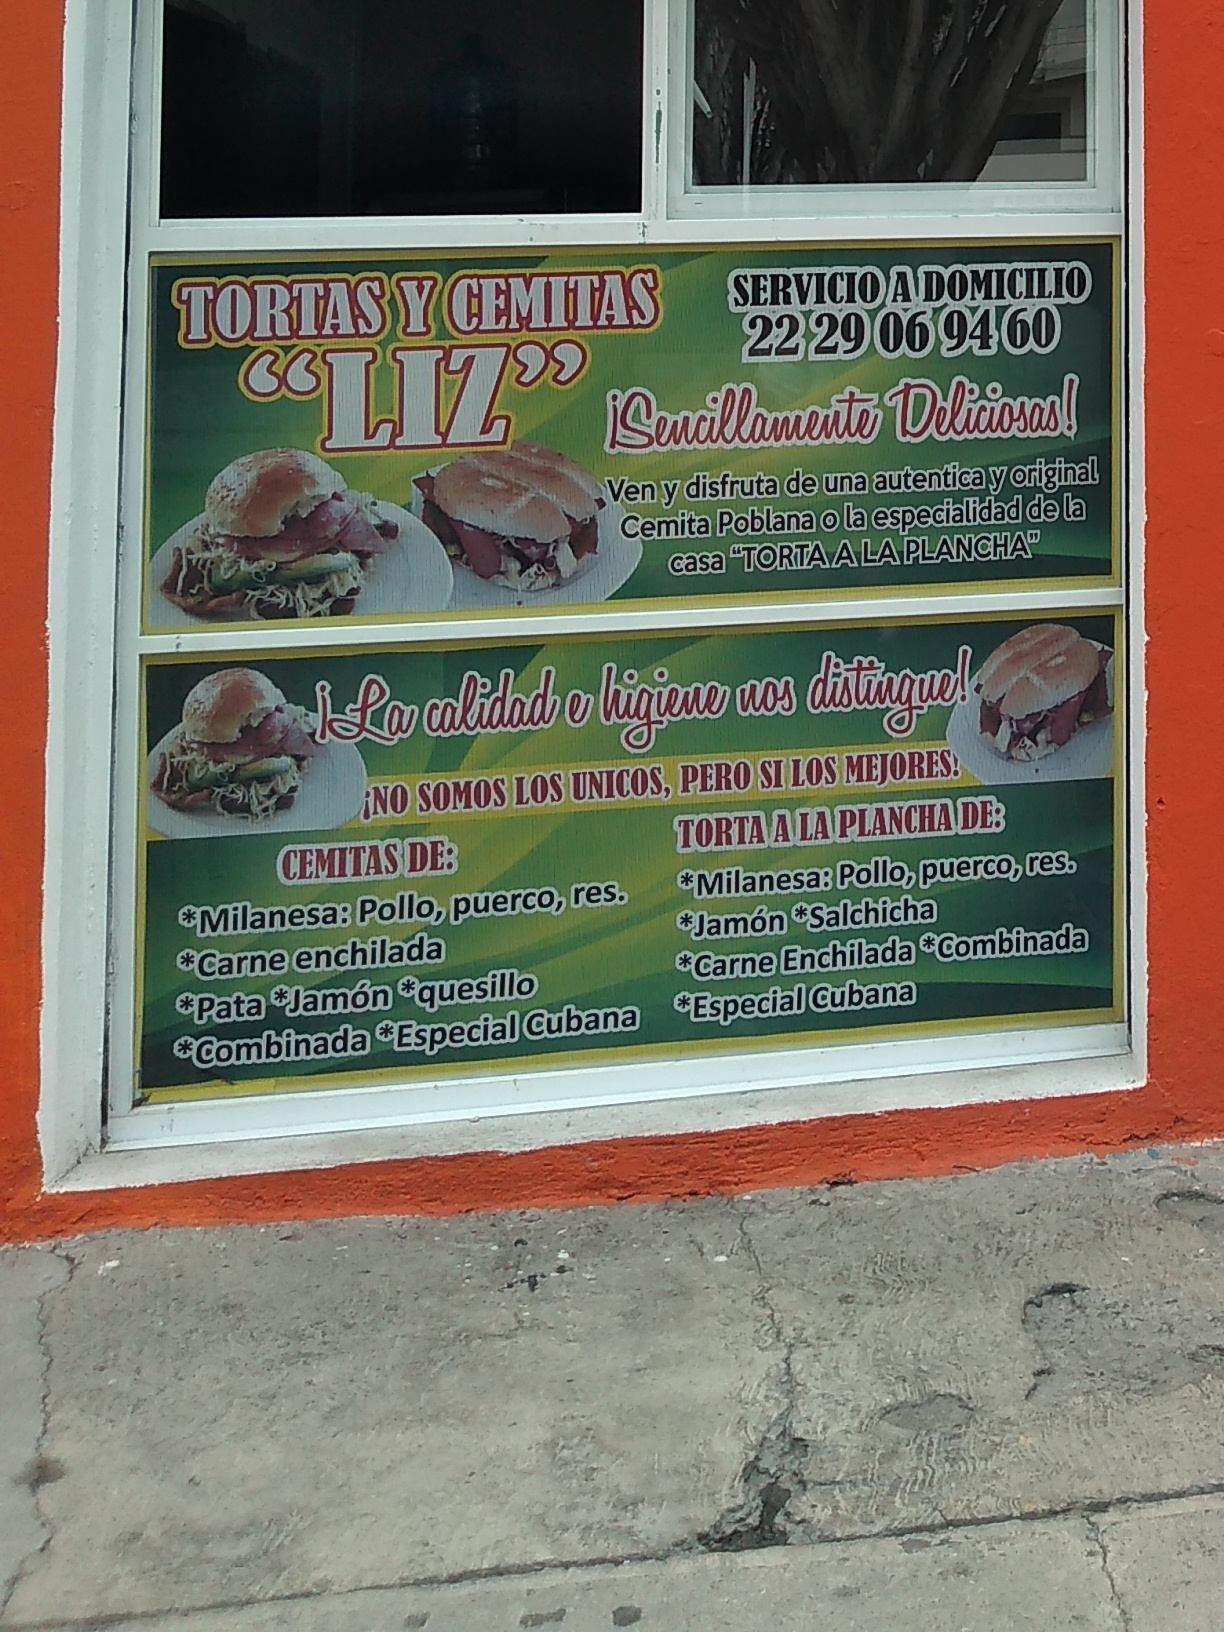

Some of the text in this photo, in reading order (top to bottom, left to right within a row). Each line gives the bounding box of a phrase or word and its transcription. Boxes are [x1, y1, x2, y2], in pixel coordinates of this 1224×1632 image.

[177, 269, 660, 343] TORTAS Y CEMITAS
[732, 266, 1088, 308] SERVICIO A DOMICILIO
[747, 306, 1056, 357] 22 29 06 94 60
[609, 377, 1076, 449] ¡Sencillamente Deliciosas!
[607, 458, 1098, 506] Ven y disfruta de una autentica y original
[620, 496, 1085, 538] Cemita Poblana o la especialidad de la
[669, 552, 724, 574] casa
[832, 542, 855, 566] A
[861, 540, 900, 566] LA
[319, 648, 970, 749] ¡La calidad e higiene nos distingue!
[363, 749, 960, 820] ¡NO SOMOS LOS UNICOS, PERO SI LOS MEJORES!
[679, 801, 1002, 849] TORTA A LA PLANCHA DE:
[281, 841, 454, 882] CEMITAS DE:
[839, 861, 912, 886] Pollo,
[921, 855, 1021, 884] puerco,
[1028, 852, 1074, 875] res.
[359, 896, 444, 923] Pollo,
[454, 888, 563, 921] puerco,
[573, 883, 625, 906] res.
[297, 938, 444, 970] enchilada
[783, 939, 912, 971] Enchilada
[812, 983, 914, 1012] Cubana
[525, 1006, 638, 1038] Cubana
